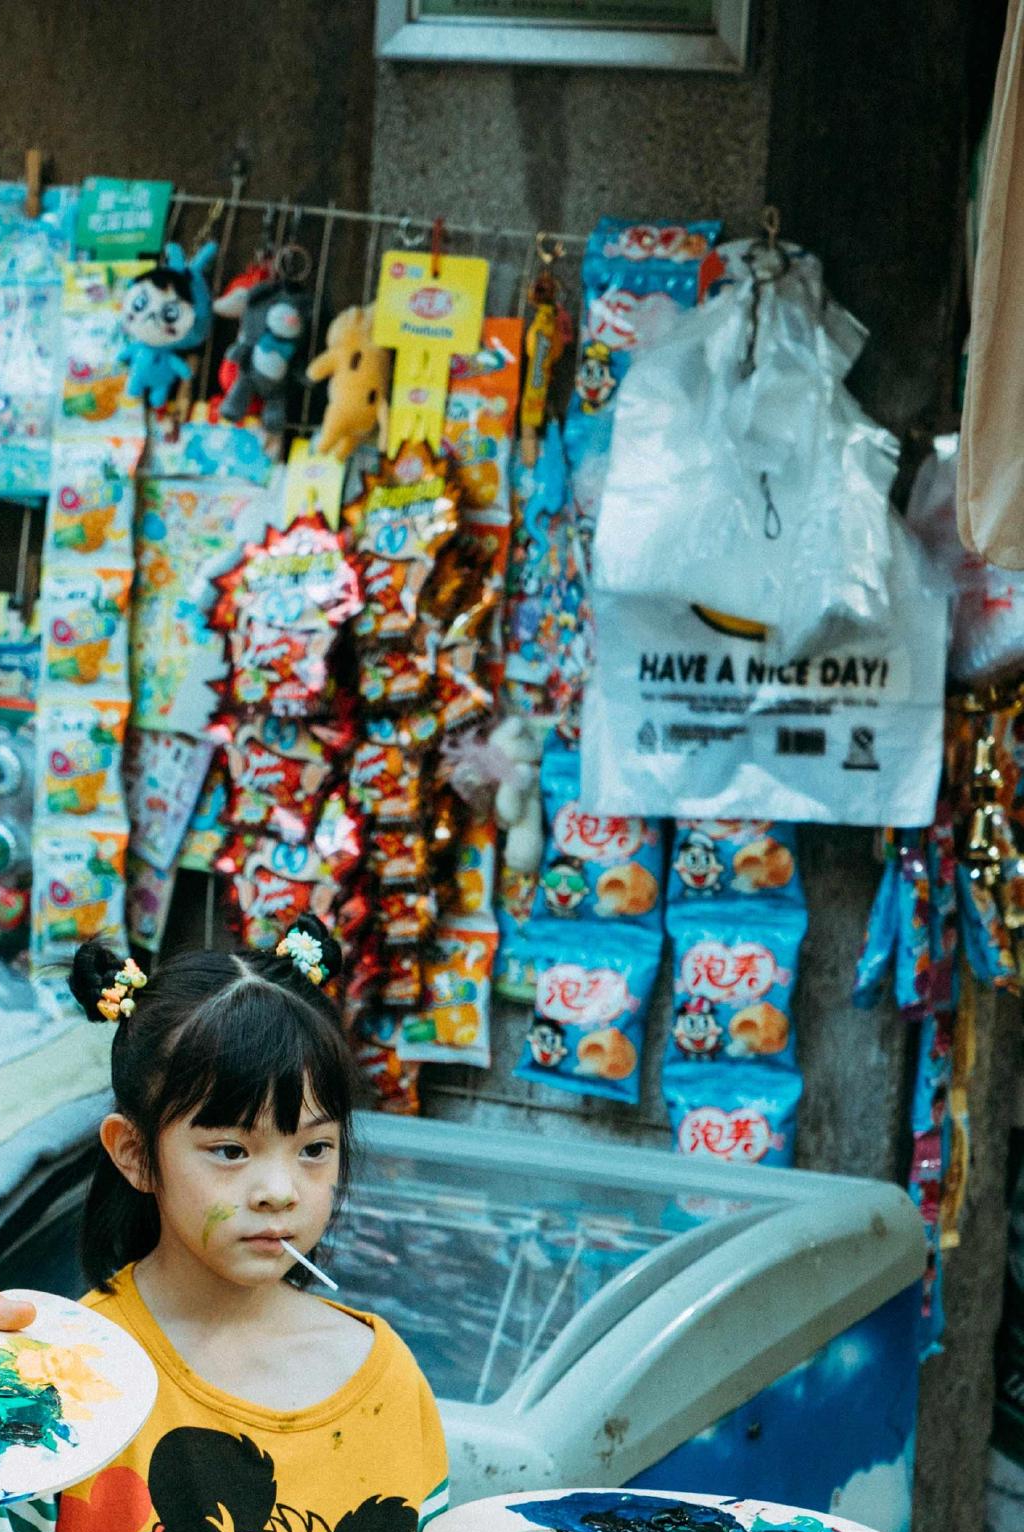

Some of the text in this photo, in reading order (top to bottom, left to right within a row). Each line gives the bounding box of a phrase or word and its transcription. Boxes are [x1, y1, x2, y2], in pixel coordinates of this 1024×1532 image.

[639, 653, 888, 688] HAVE A NICE DAY!
[692, 953, 768, 988] 泡芙
[690, 1118, 763, 1154] 泡芙
